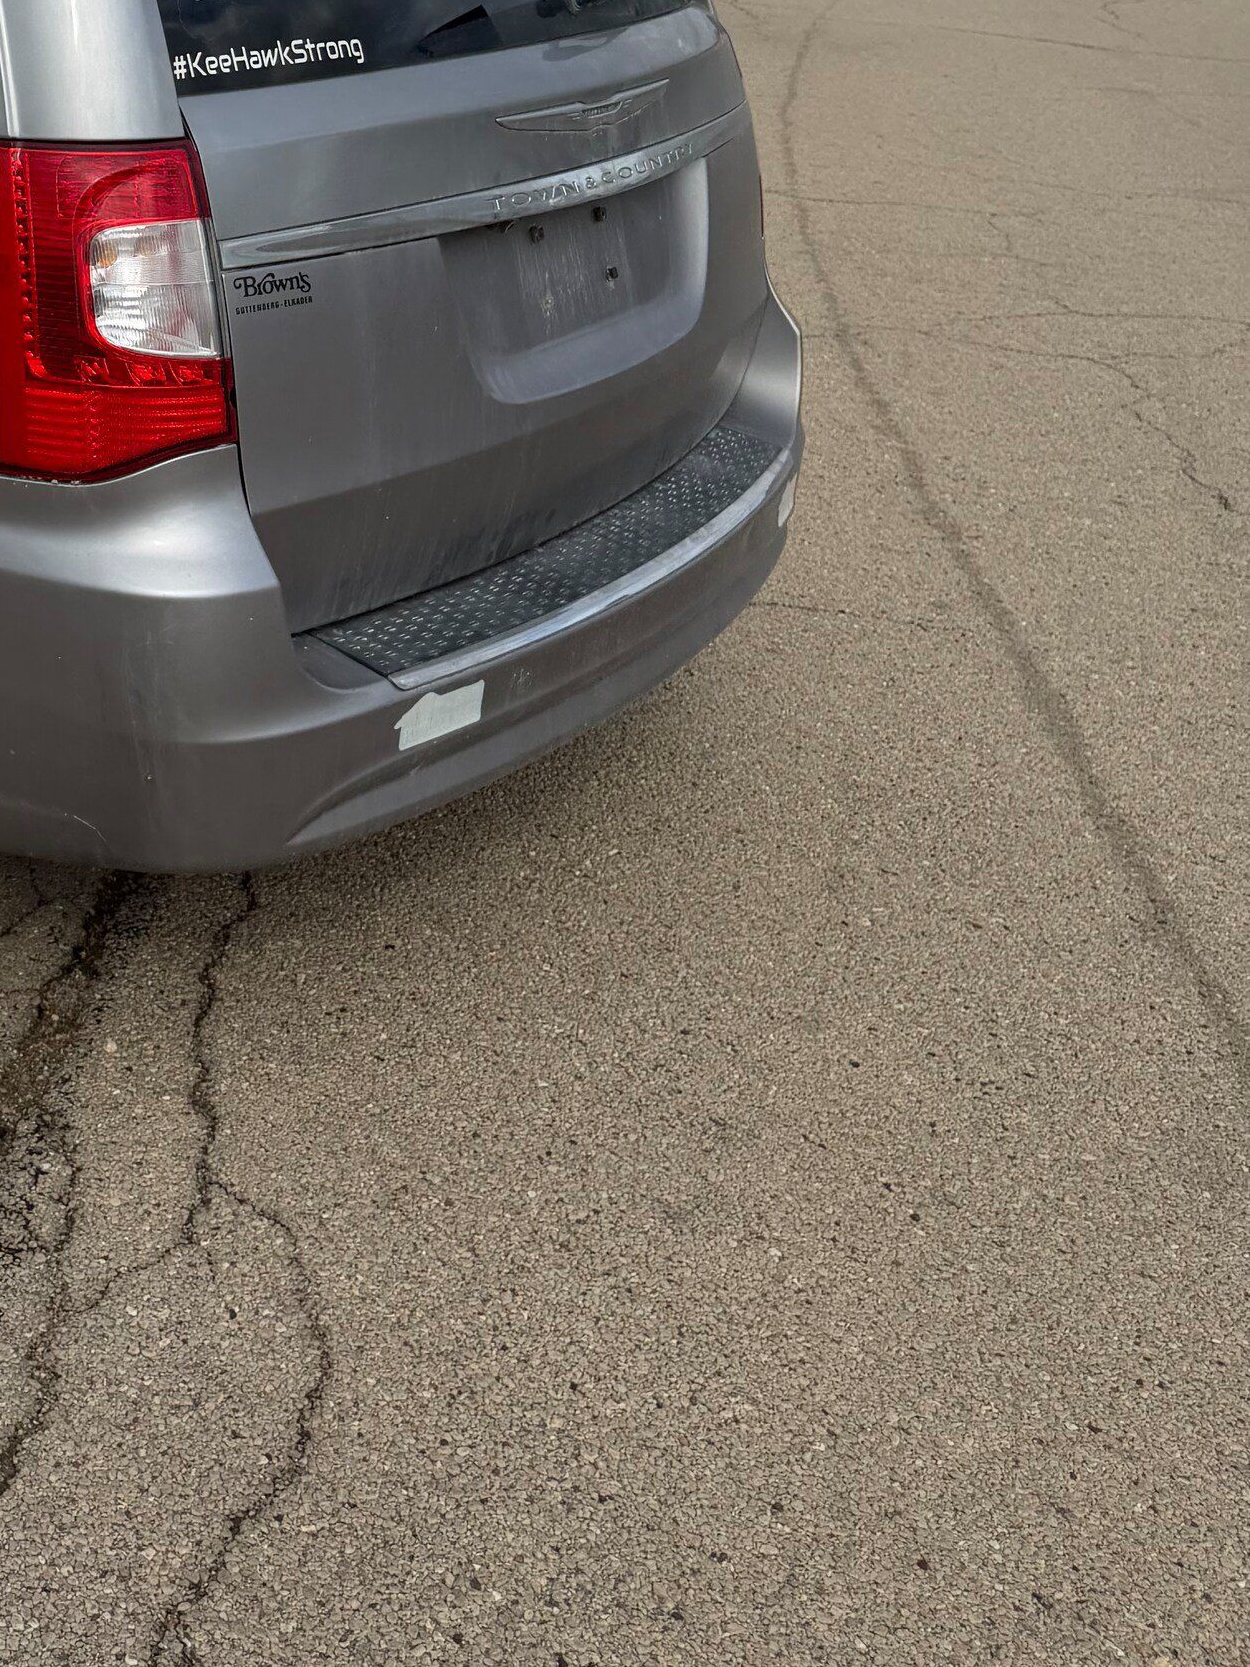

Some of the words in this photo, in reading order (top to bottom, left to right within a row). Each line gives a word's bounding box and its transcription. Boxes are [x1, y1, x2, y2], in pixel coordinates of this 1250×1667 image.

[174, 39, 364, 79] #KeeHawkStrong
[486, 180, 580, 211] TOWN
[585, 176, 597, 189] &
[601, 143, 693, 184] COUNTRY
[233, 272, 311, 297] Brown's
